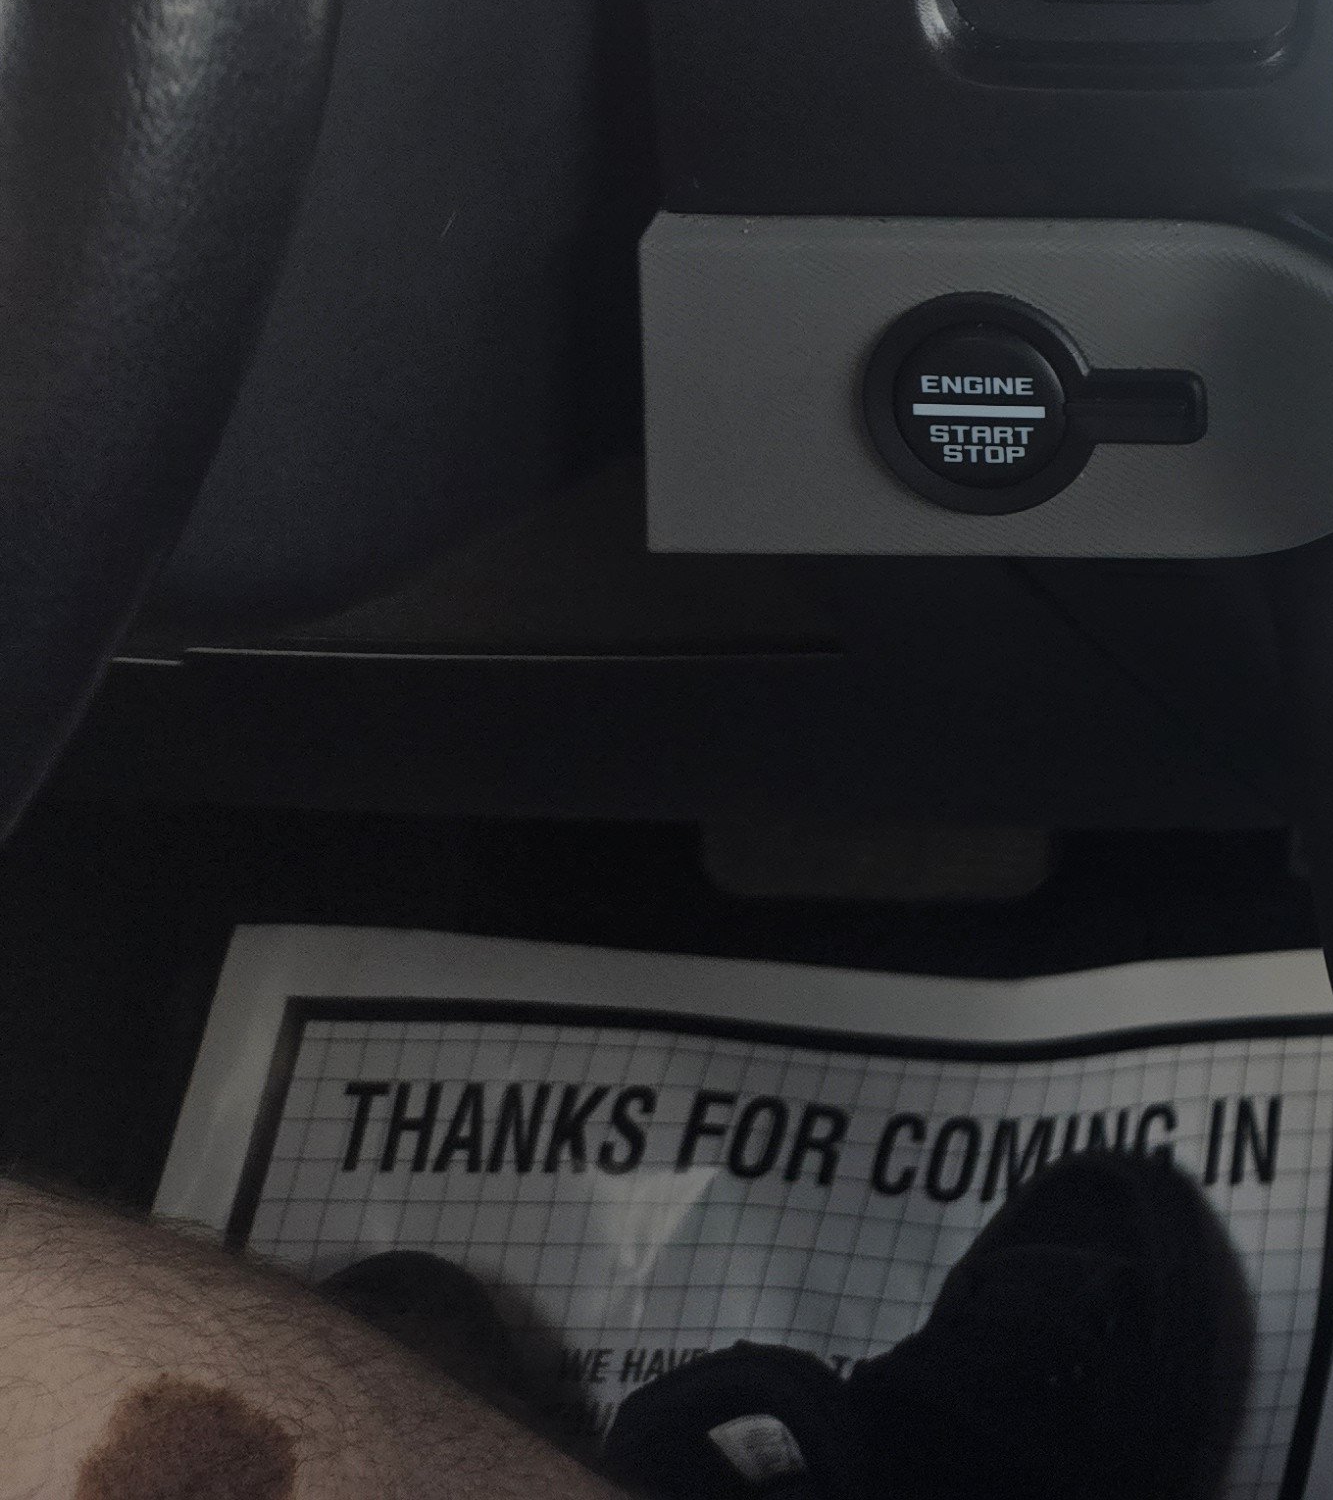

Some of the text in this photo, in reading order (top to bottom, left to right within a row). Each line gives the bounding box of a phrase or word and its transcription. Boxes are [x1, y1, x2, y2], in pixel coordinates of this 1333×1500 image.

[920, 375, 1034, 396] ENGINE
[929, 425, 1035, 445] START
[943, 445, 1026, 464] STOP
[342, 1081, 658, 1175] THANKS
[674, 1088, 850, 1186] FOR
[1205, 1095, 1283, 1187] IN
